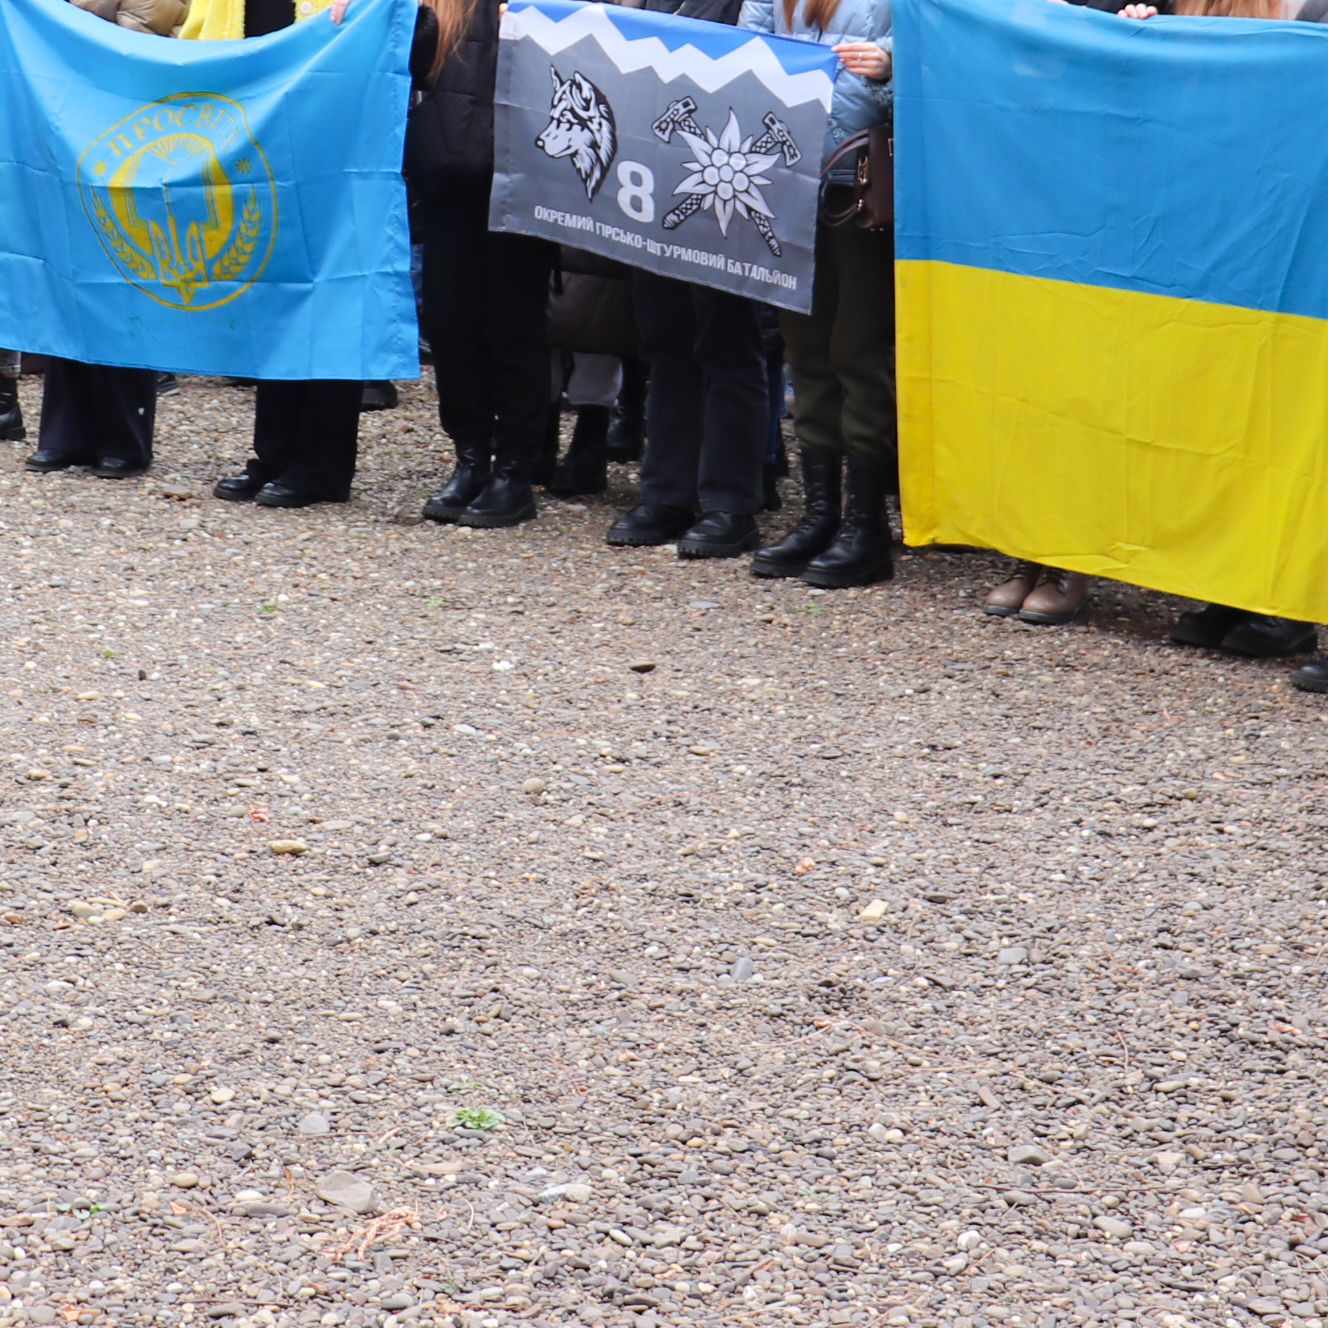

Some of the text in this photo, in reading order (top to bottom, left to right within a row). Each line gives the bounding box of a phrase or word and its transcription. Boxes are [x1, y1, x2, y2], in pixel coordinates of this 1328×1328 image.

[106, 103, 239, 158] ПРОСВІТА
[616, 159, 655, 223] 8
[534, 205, 797, 290] ОКРЕМИЙ ГІРСЬКО-ШТУРМОВИЙ БАТАЛЬЙОН
